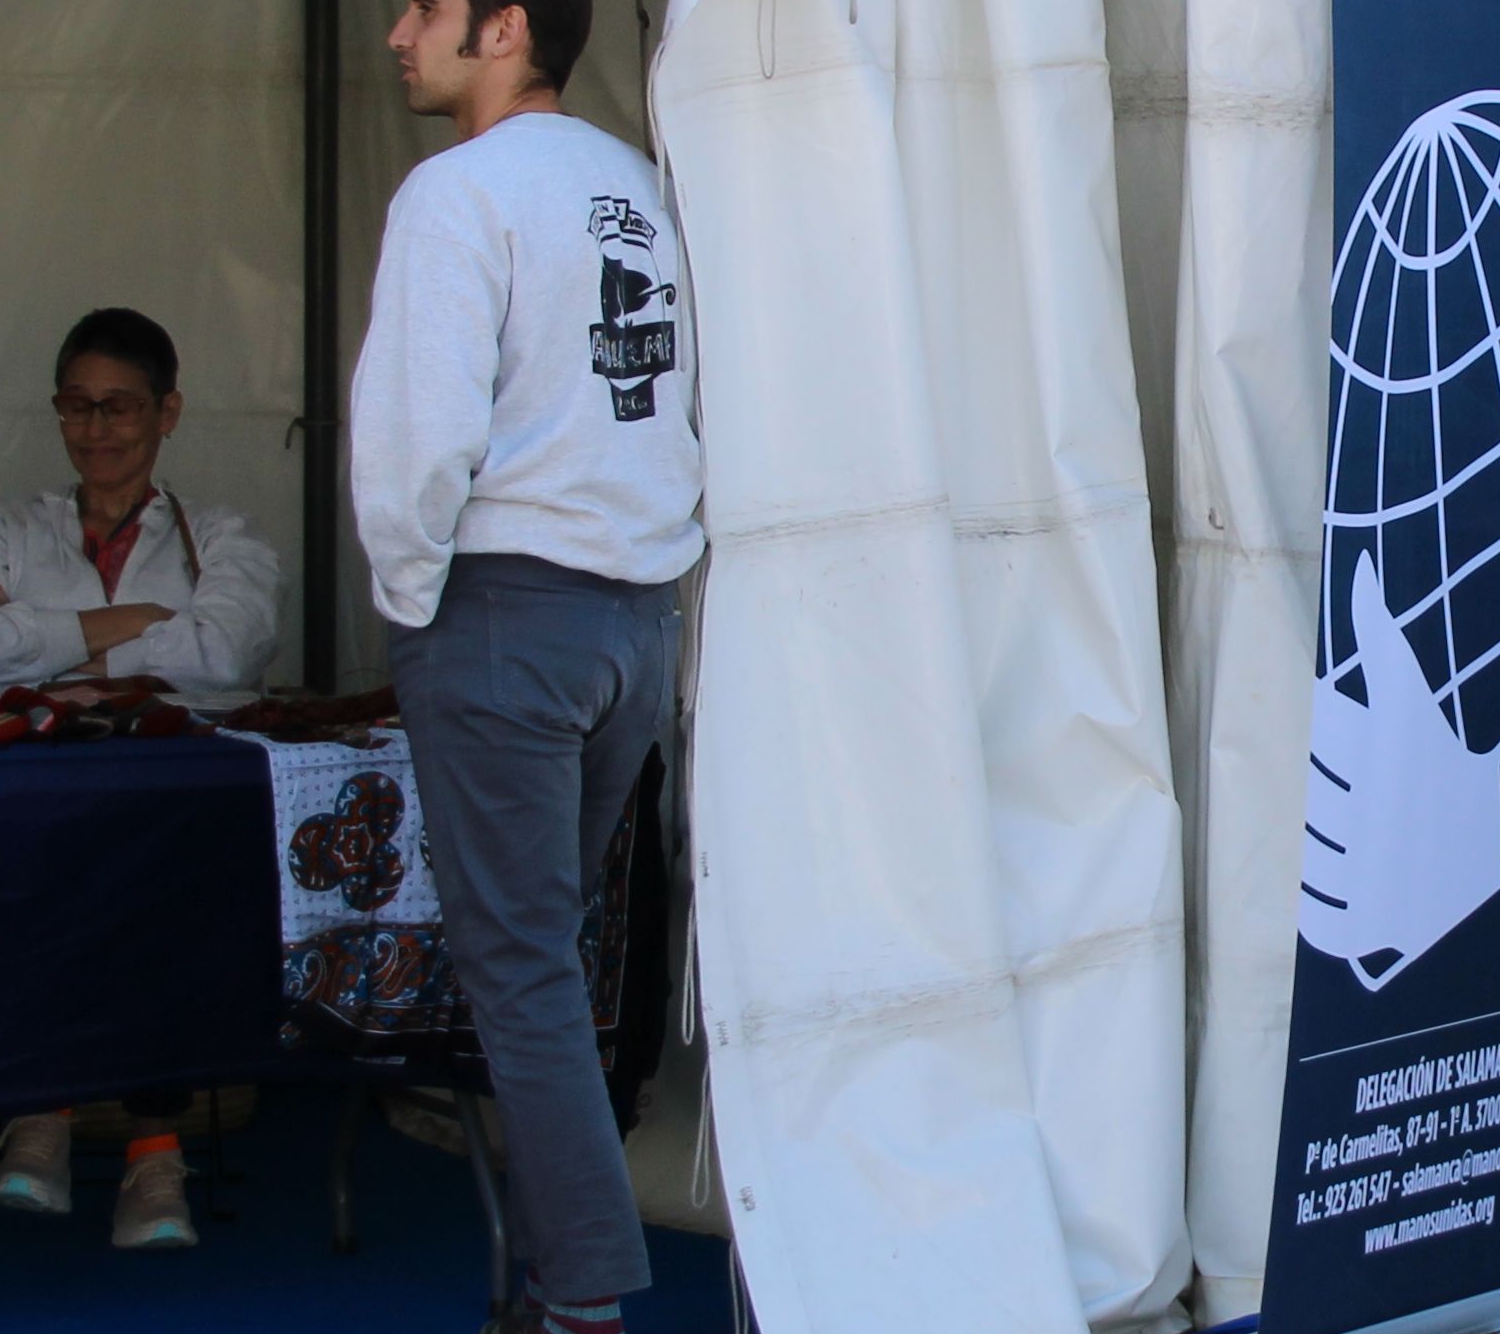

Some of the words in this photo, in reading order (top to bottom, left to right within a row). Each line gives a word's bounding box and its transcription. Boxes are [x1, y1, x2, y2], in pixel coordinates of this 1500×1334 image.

[1356, 1056, 1433, 1113] DELEGACIÓN
[1436, 1055, 1455, 1091] DE
[1322, 1137, 1338, 1170] de
[1340, 1123, 1403, 1166] Carmelitas,
[1406, 1110, 1439, 1149] 87-91
[1461, 1102, 1473, 1133] A.
[1296, 1193, 1323, 1226] Tel.:
[1324, 1180, 1347, 1218] 923
[1347, 1175, 1367, 1212] 261
[1369, 1170, 1392, 1206] 547
[1364, 1195, 1495, 1254] www.manosunidas.org
